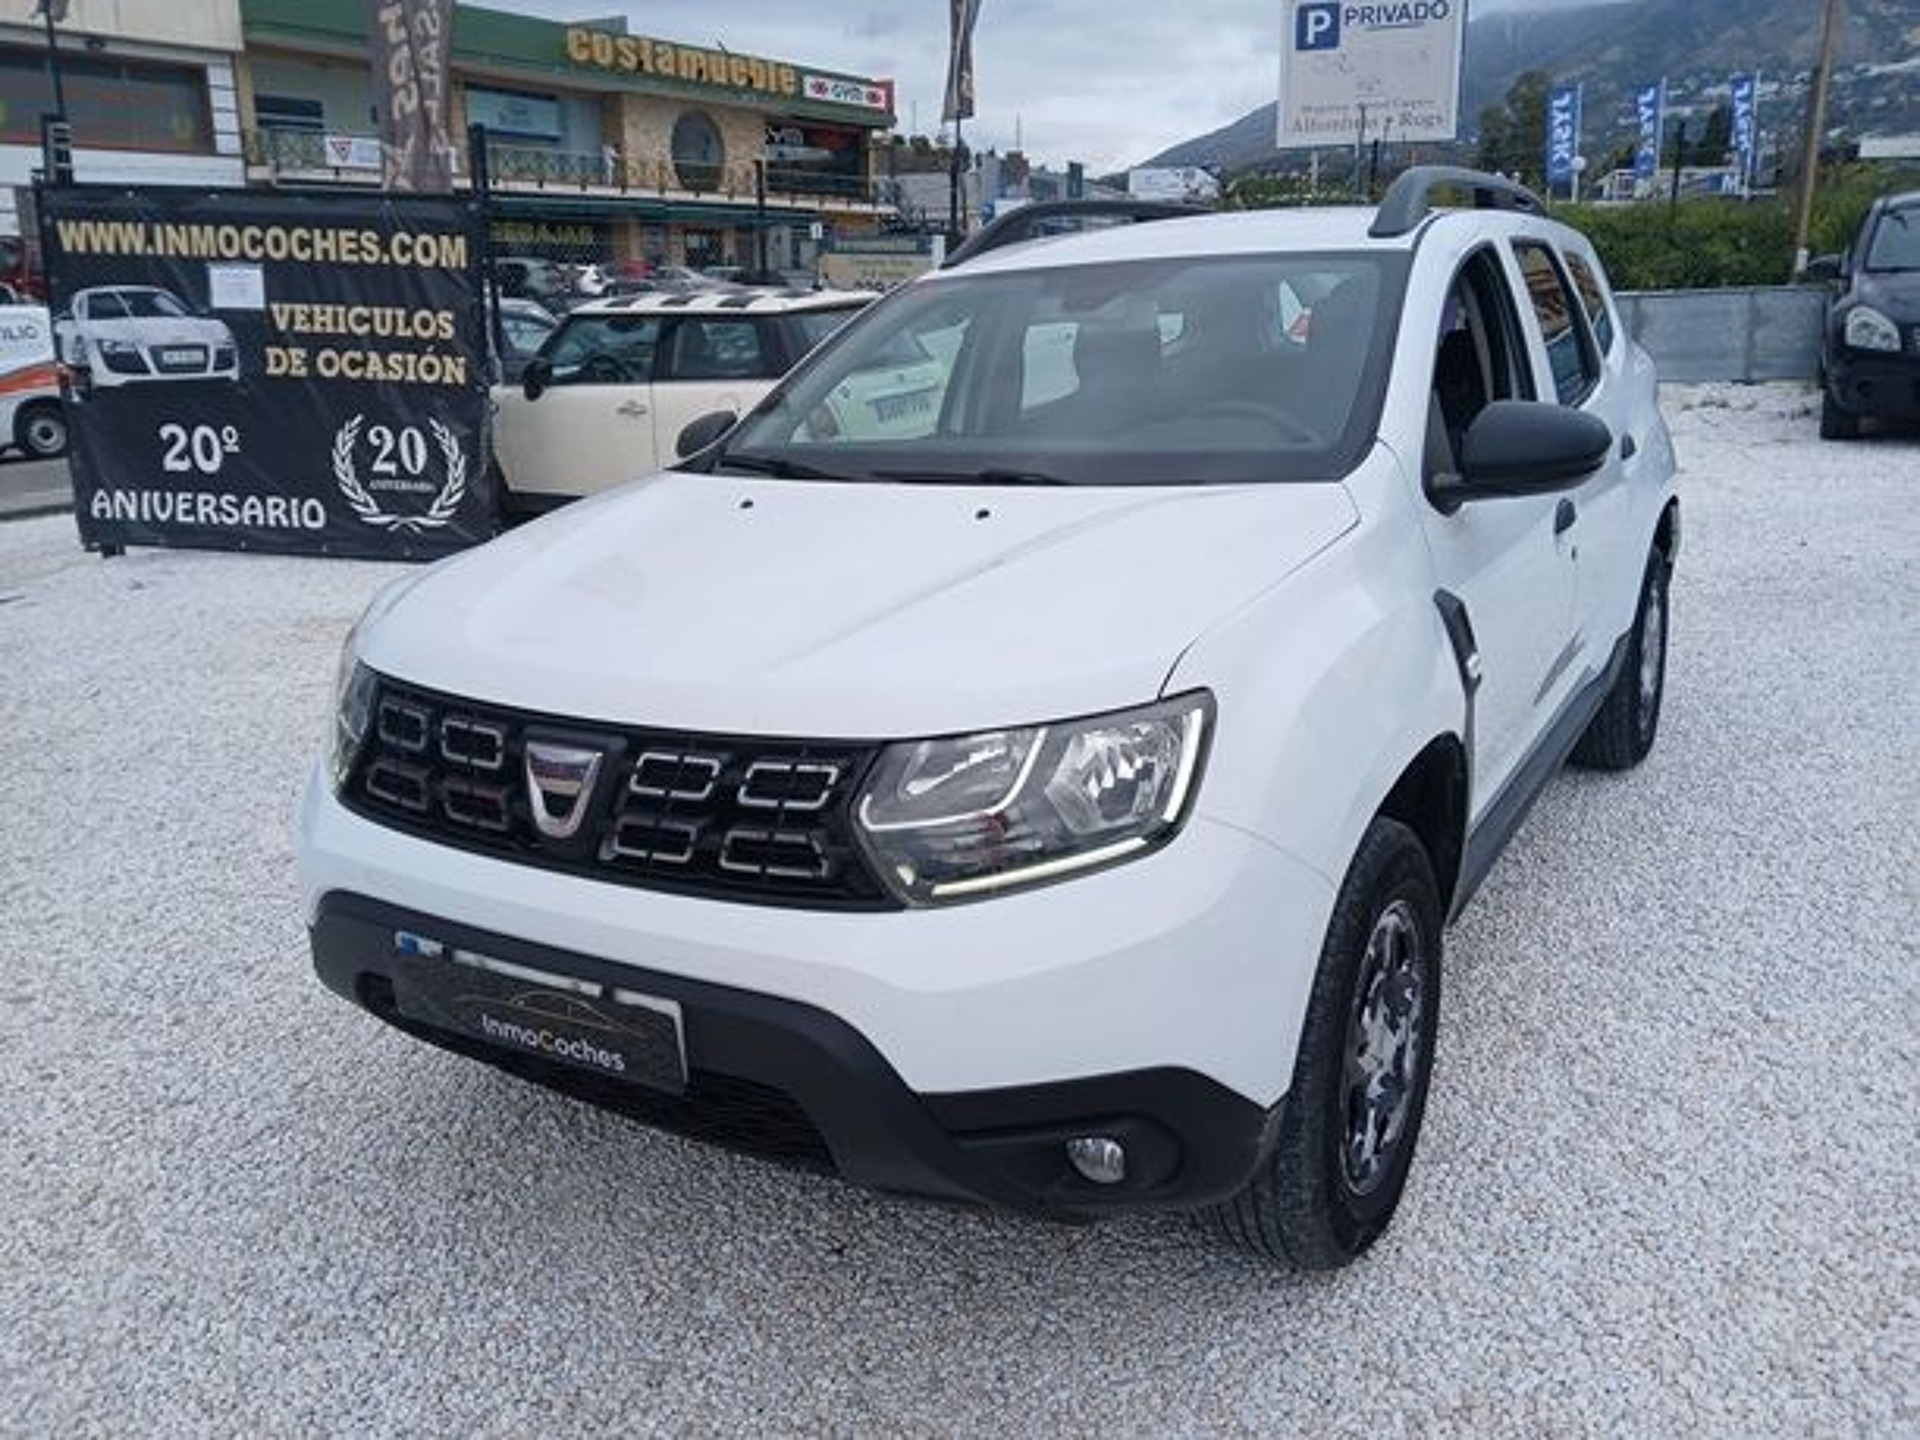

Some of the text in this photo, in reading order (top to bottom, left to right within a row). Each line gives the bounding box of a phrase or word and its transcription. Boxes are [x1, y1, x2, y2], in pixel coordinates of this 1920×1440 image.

[1306, 10, 1331, 45] P
[1344, 1, 1450, 26] PRIVADO
[57, 220, 468, 268] WWW.INMOCOCHES.COM
[269, 302, 456, 340] VEHICULOS
[265, 345, 467, 385] DE OCASIÓN
[159, 423, 240, 473] 20º
[368, 426, 428, 477] 20
[91, 489, 327, 530] ANIVERSARIO
[481, 1012, 626, 1072] InmoCoches
